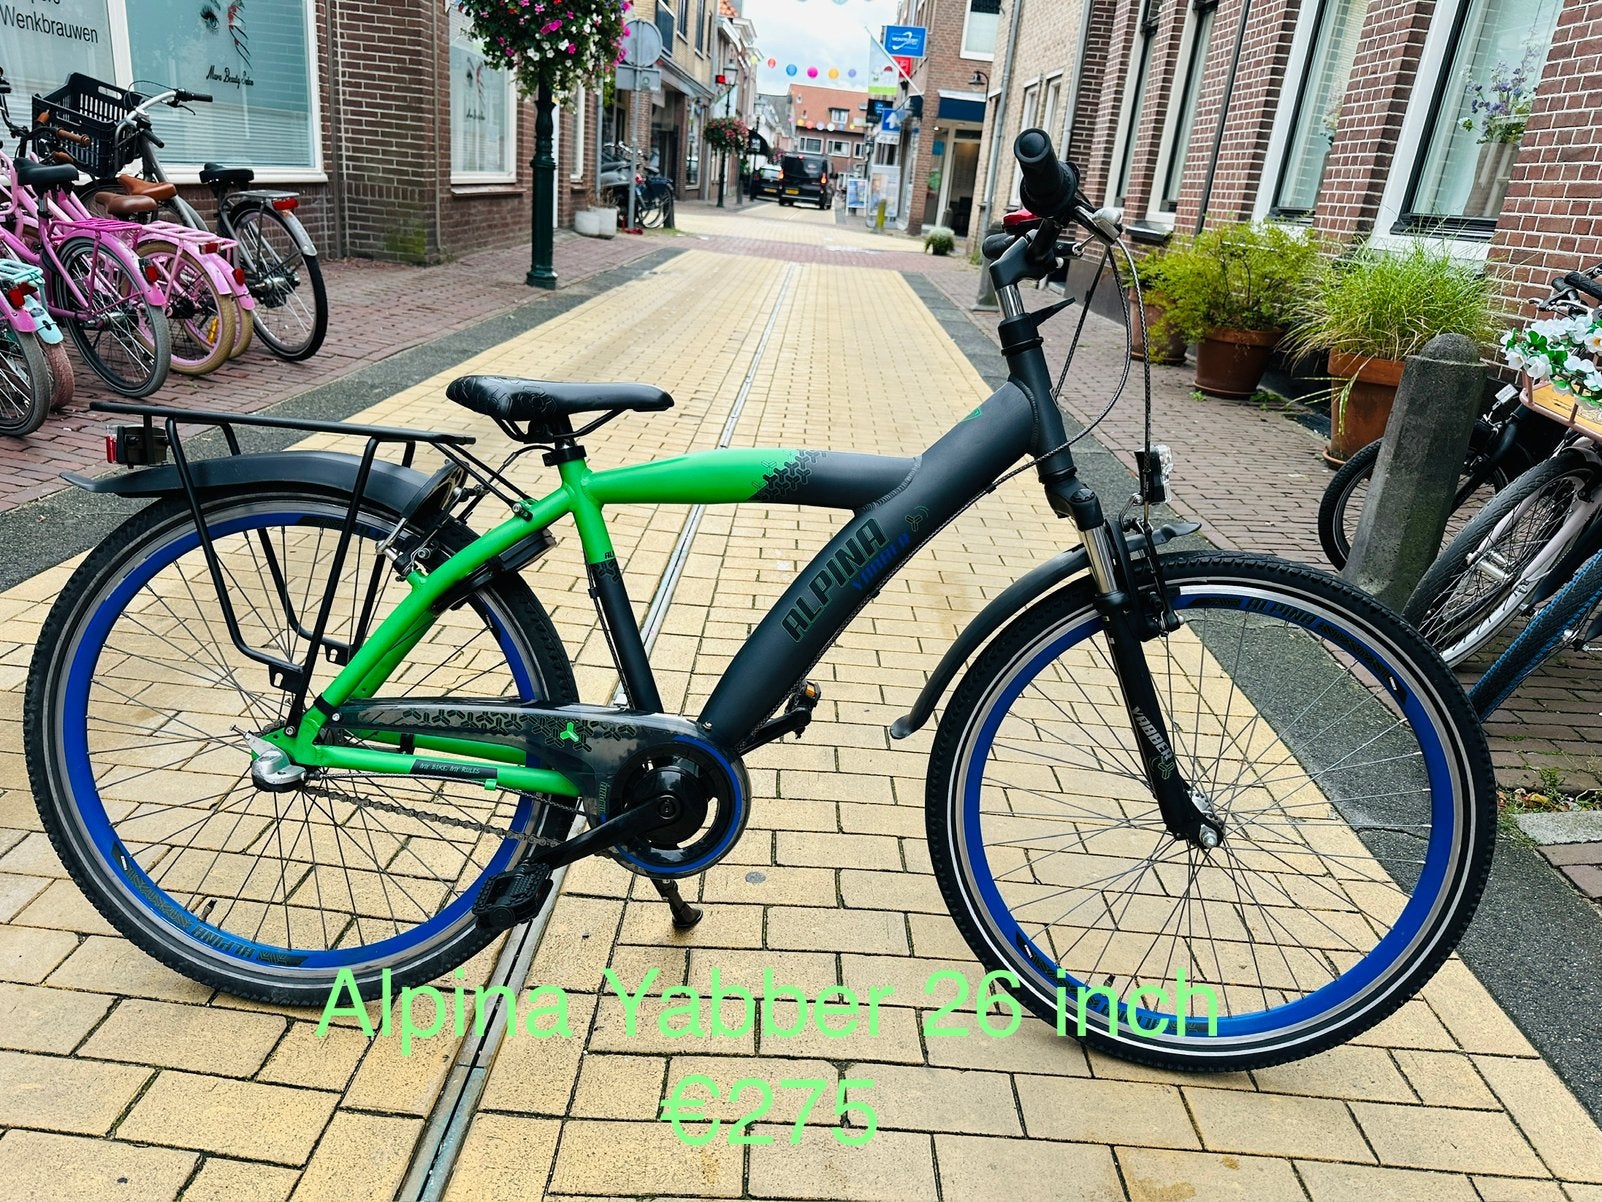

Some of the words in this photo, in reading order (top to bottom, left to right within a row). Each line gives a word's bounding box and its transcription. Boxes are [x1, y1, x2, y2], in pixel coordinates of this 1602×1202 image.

[0, 4, 98, 43] Wenkbrauwen
[780, 518, 890, 643] ALPINA
[431, 763, 447, 772] BIKE
[461, 766, 480, 774] RULES
[192, 925, 256, 958] ALPINA
